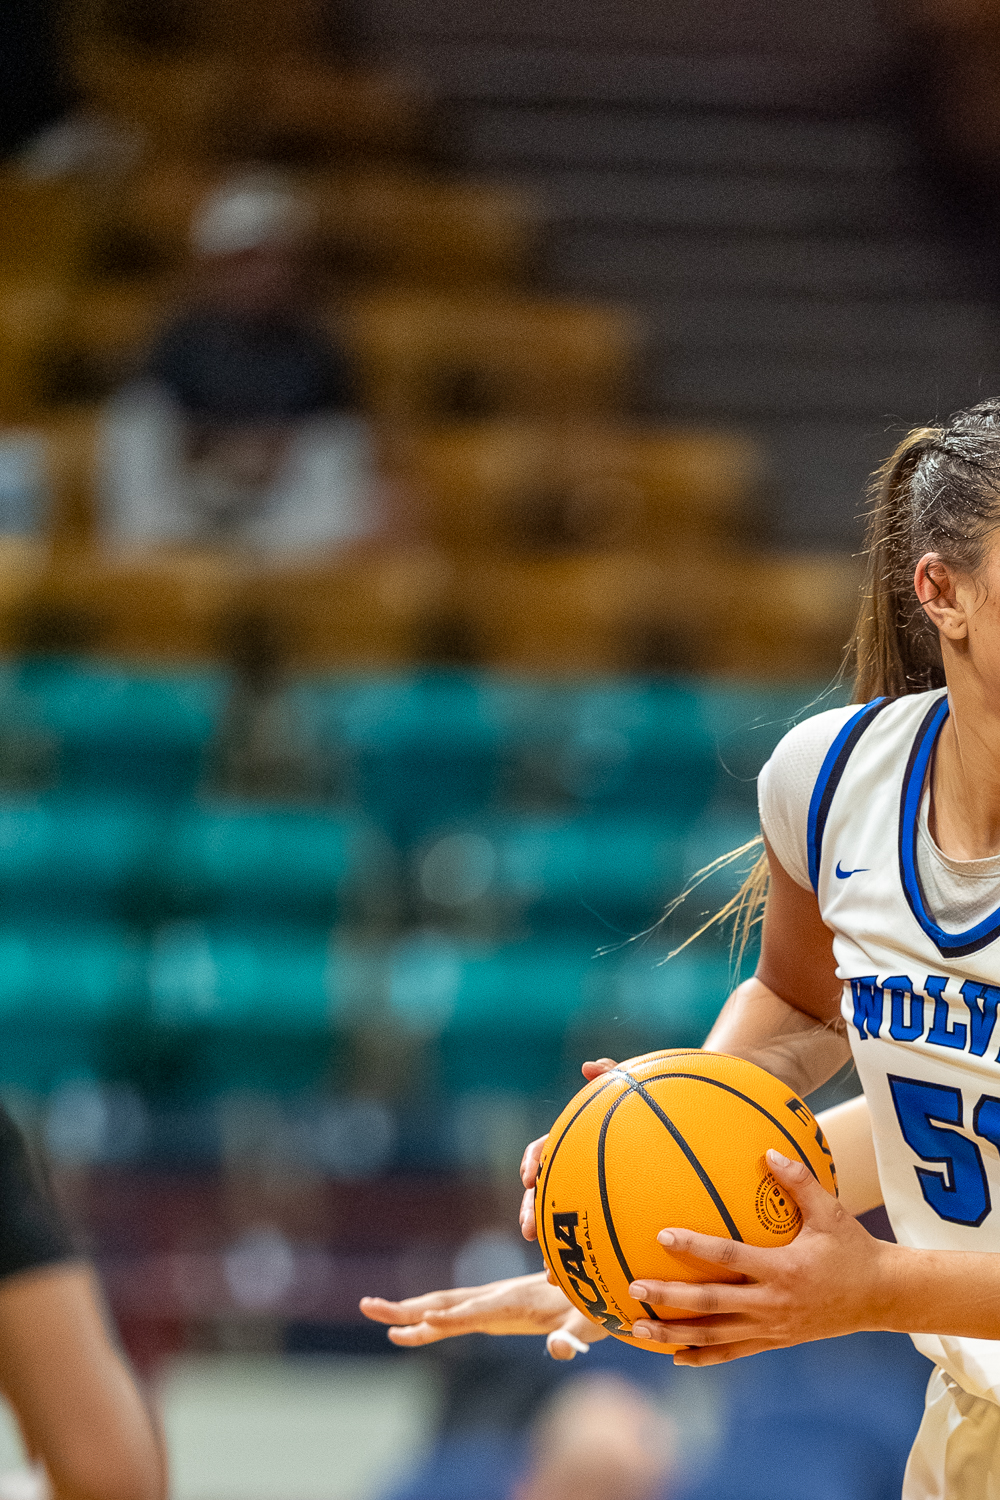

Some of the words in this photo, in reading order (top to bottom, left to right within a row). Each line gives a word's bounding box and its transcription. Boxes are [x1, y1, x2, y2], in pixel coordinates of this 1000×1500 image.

[582, 1210, 593, 1250] BALL
[552, 1211, 633, 1337] NCAA
[589, 1254, 610, 1293] GAME
